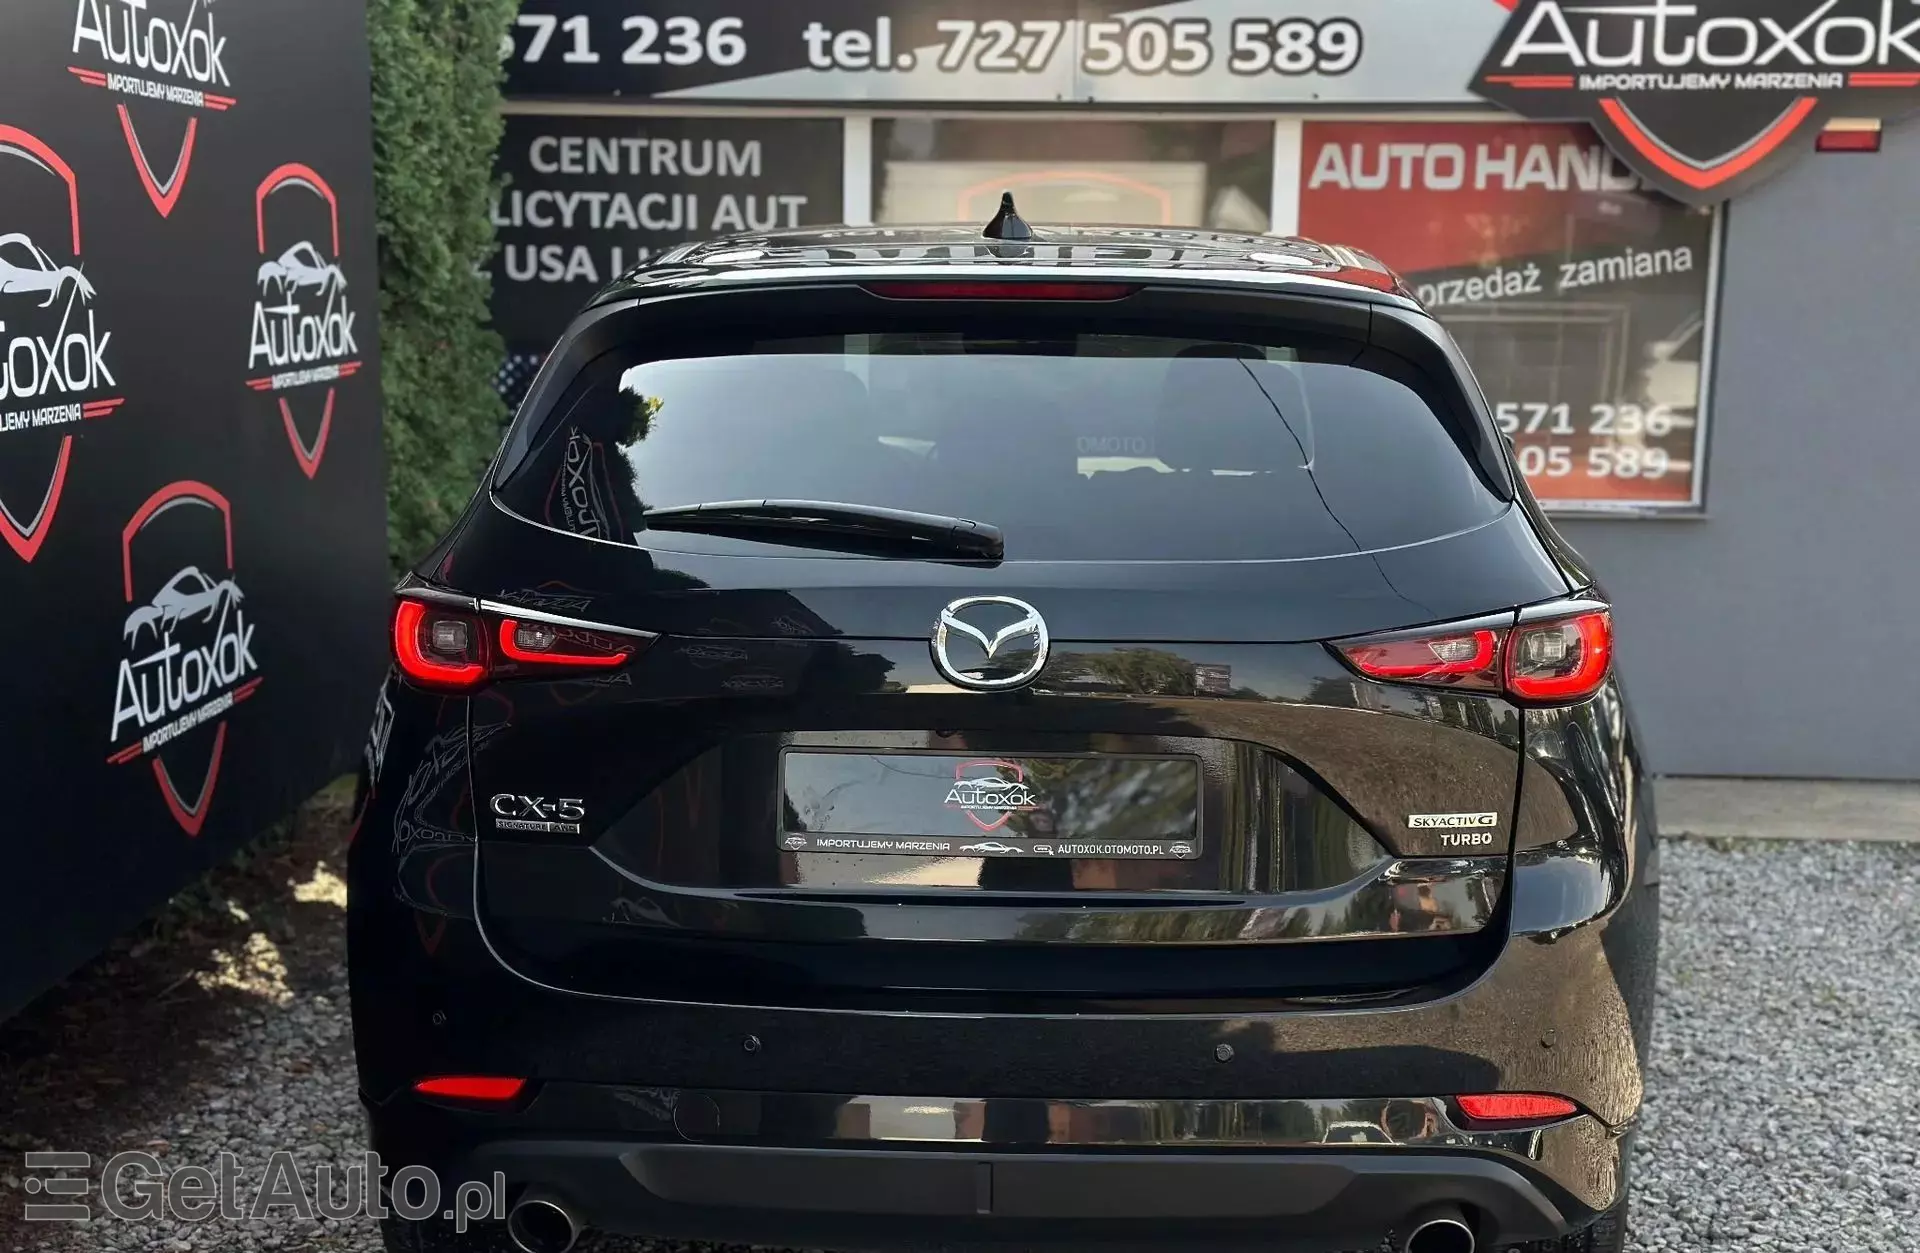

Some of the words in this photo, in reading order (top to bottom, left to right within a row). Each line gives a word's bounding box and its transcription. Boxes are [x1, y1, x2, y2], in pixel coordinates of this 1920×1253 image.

[73, 0, 230, 87] Autoxok
[622, 16, 747, 66] 236
[803, 16, 915, 68] tel.
[937, 20, 1061, 70] 727
[1084, 20, 1211, 72] 505
[1229, 20, 1361, 72] 589
[1501, 0, 1920, 67] Autoxok
[107, 72, 165, 100] IMPORTUJEMY
[1579, 73, 1731, 91] IMPORTUJEMY
[1735, 72, 1843, 89] MARZENIA
[529, 135, 762, 177] CENTRUM
[1307, 142, 1466, 190] AUTO
[489, 190, 698, 230] LICYTACJI
[711, 195, 808, 231] AUT
[505, 244, 599, 283] USA
[1559, 246, 1693, 288] zamiana
[248, 285, 358, 369] Autoxok
[32, 403, 82, 428] MARZENIA
[1495, 402, 1575, 435] 571
[1589, 404, 1672, 437] 236
[1587, 447, 1669, 479] 589
[110, 592, 258, 742] Autoxok
[489, 793, 585, 821] CX-5
[944, 786, 1037, 806] Autoxok
[816, 838, 894, 849] IMPORTUJEMY
[896, 841, 950, 850] MARZENIA
[1058, 844, 1164, 855] AUTOXOK.OTOMOTO.PL
[1440, 831, 1493, 846] TURBO
